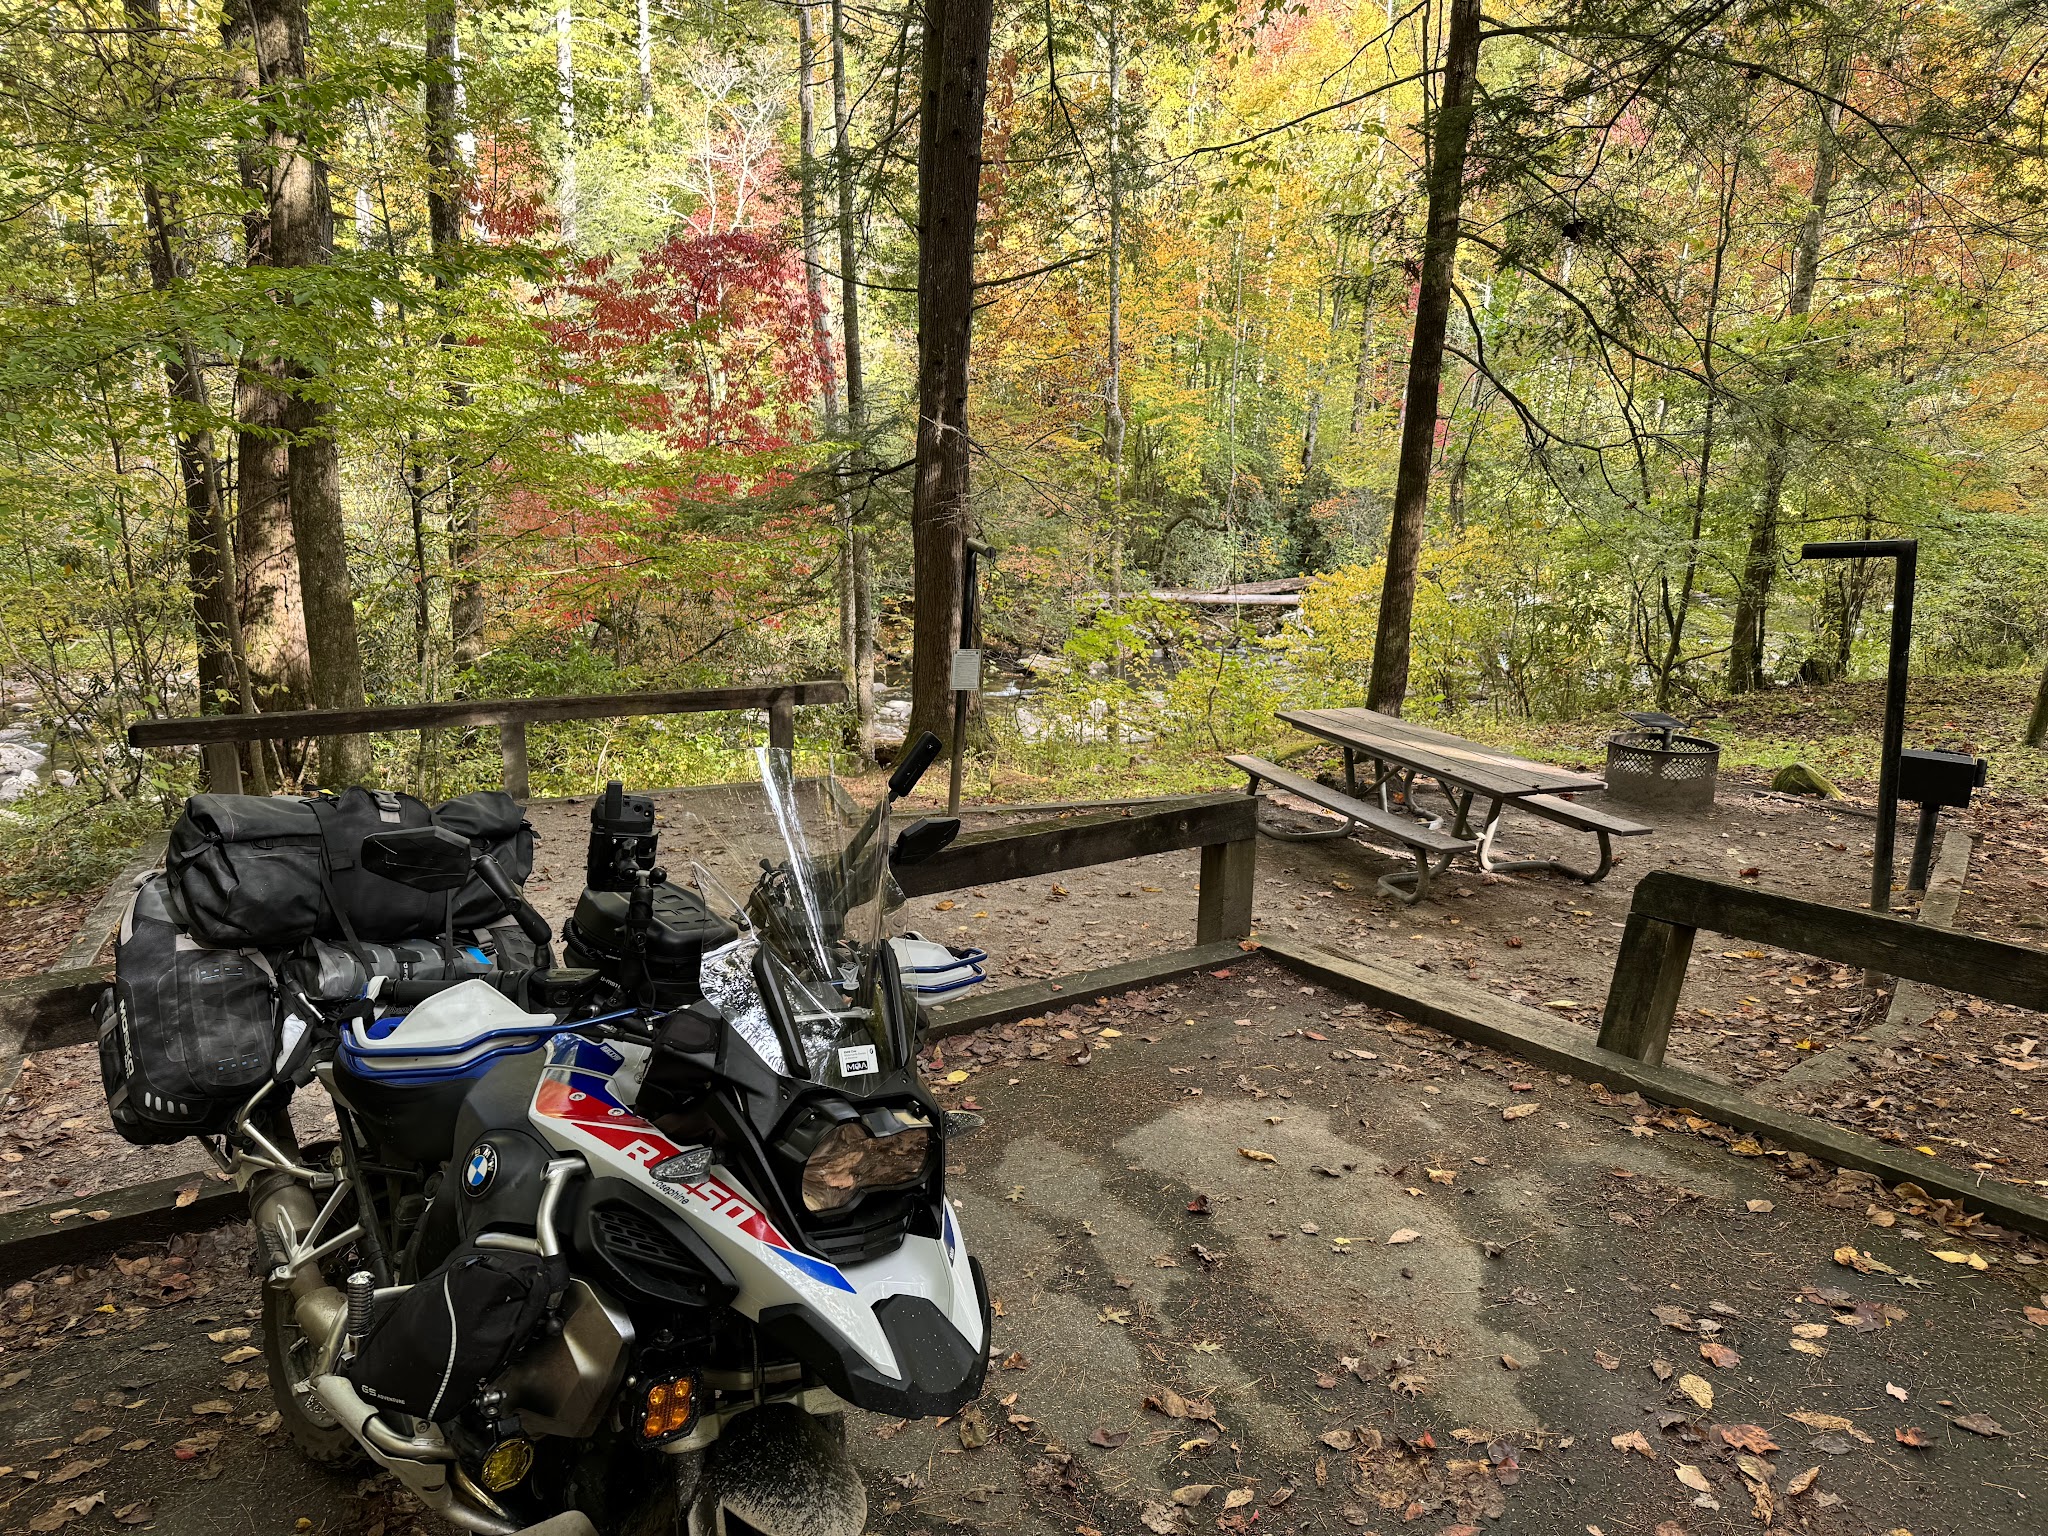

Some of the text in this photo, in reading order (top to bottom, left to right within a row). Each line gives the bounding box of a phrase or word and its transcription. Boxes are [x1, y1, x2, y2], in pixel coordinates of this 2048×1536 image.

[119, 998, 135, 1076] MOSKO
[620, 1139, 661, 1169] R
[361, 1384, 377, 1397] GS
